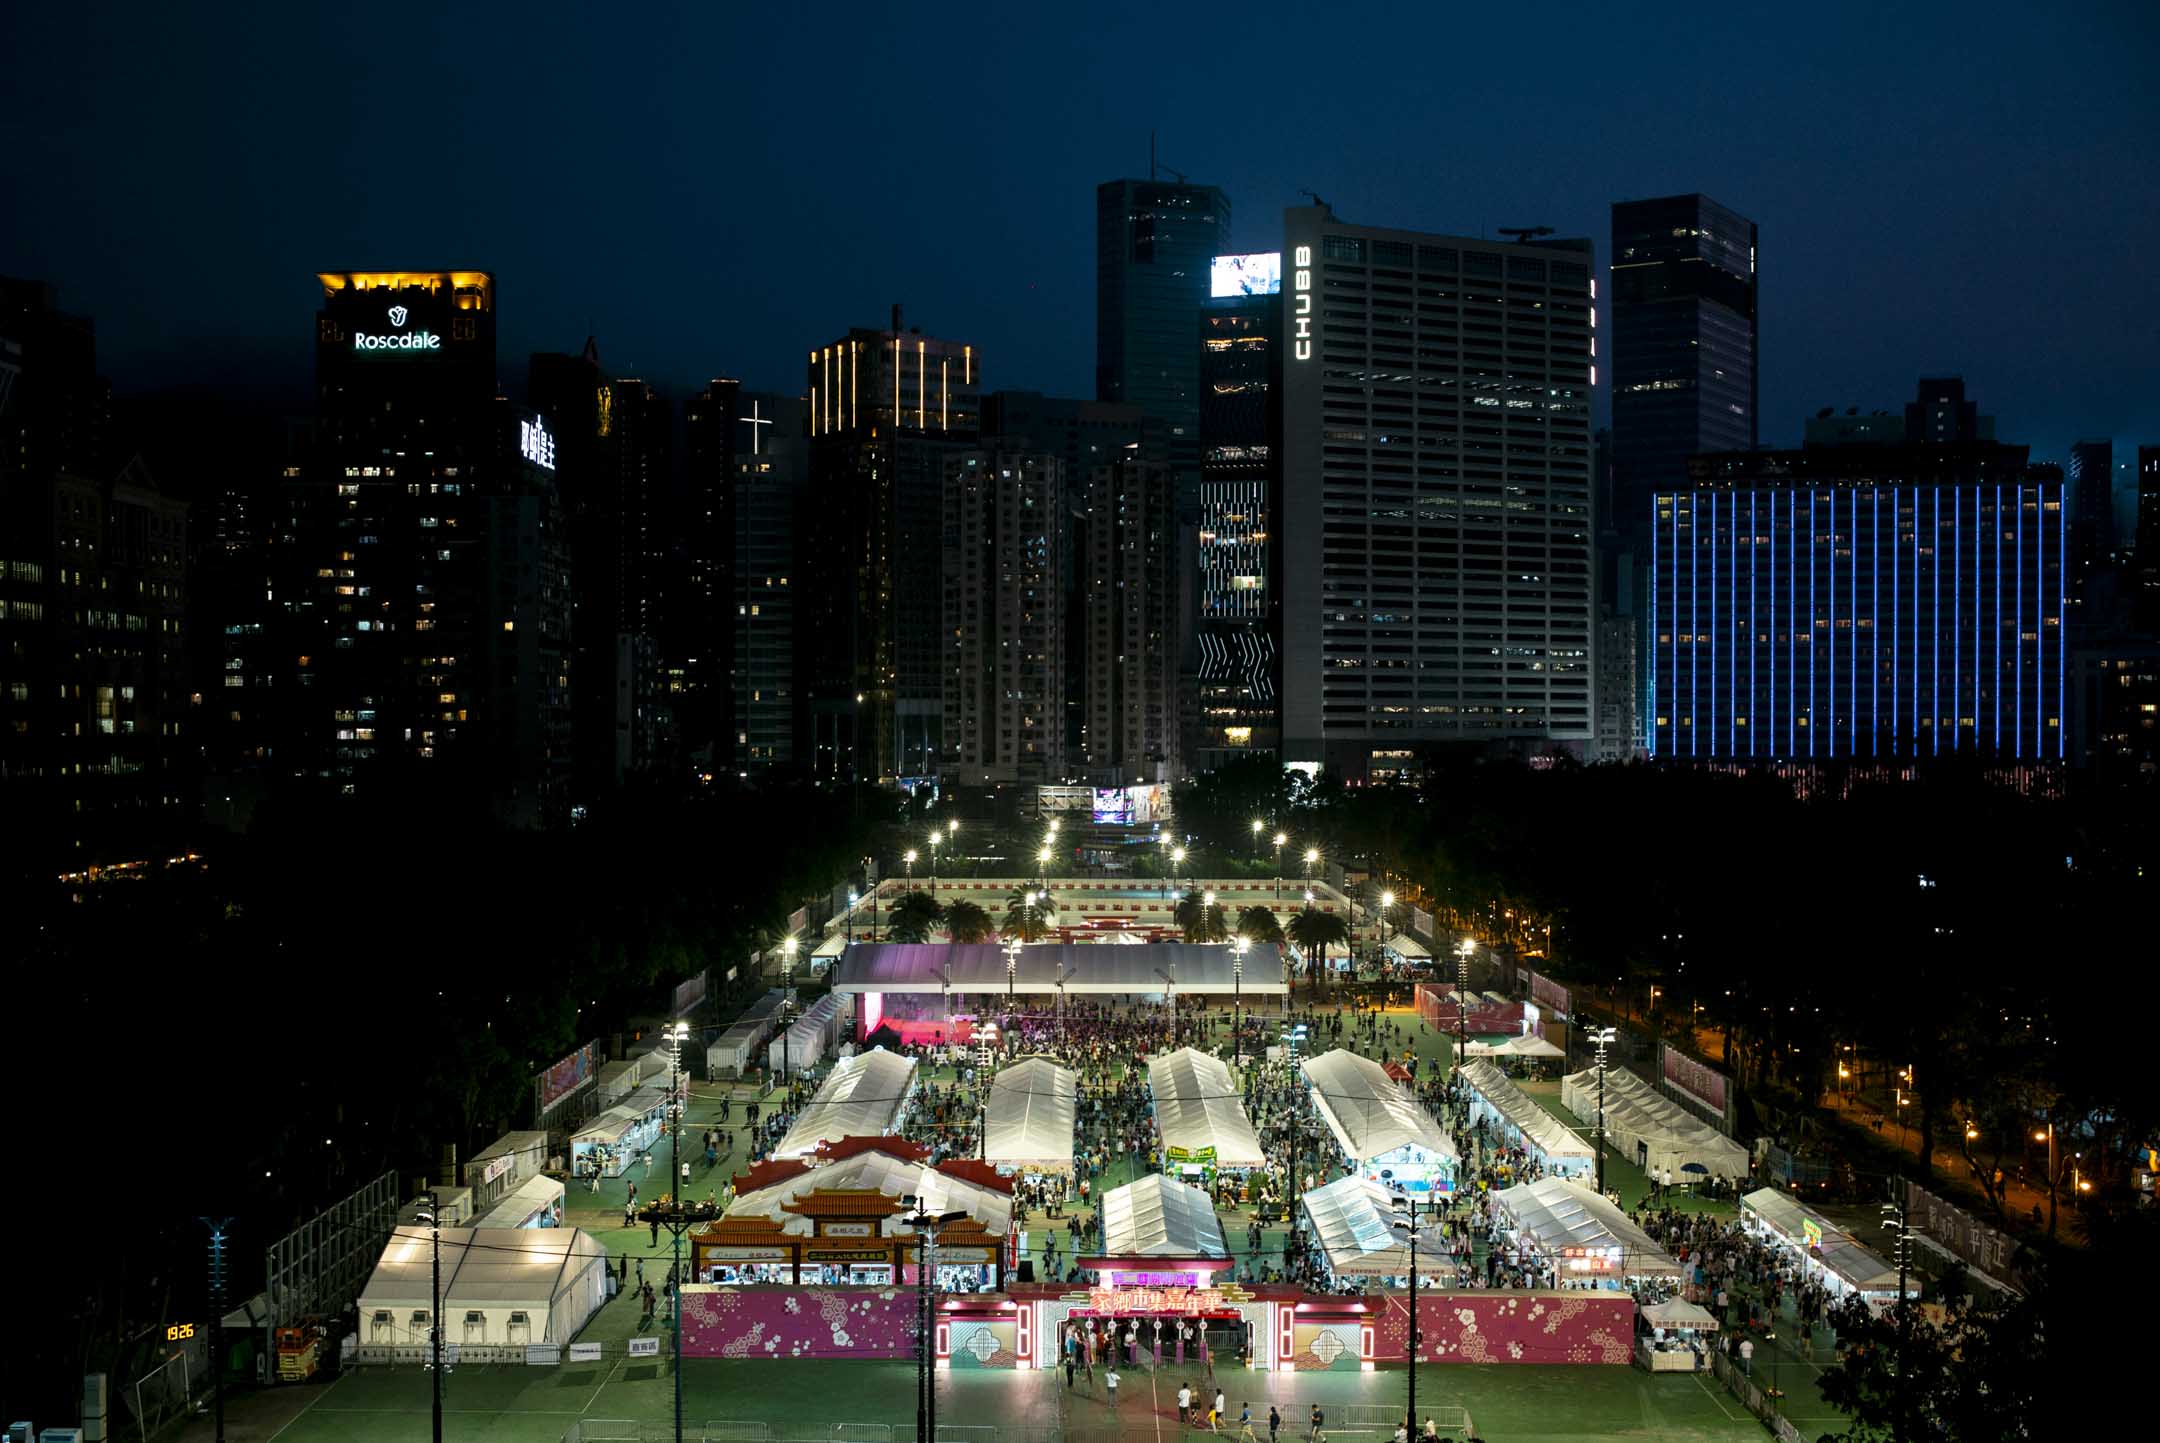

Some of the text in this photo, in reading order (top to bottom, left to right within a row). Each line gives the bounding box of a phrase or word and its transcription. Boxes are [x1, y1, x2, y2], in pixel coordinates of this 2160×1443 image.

[1295, 246, 1311, 360] CHUBB
[1089, 1287, 1223, 1316] 家鄉市集嘉年華
